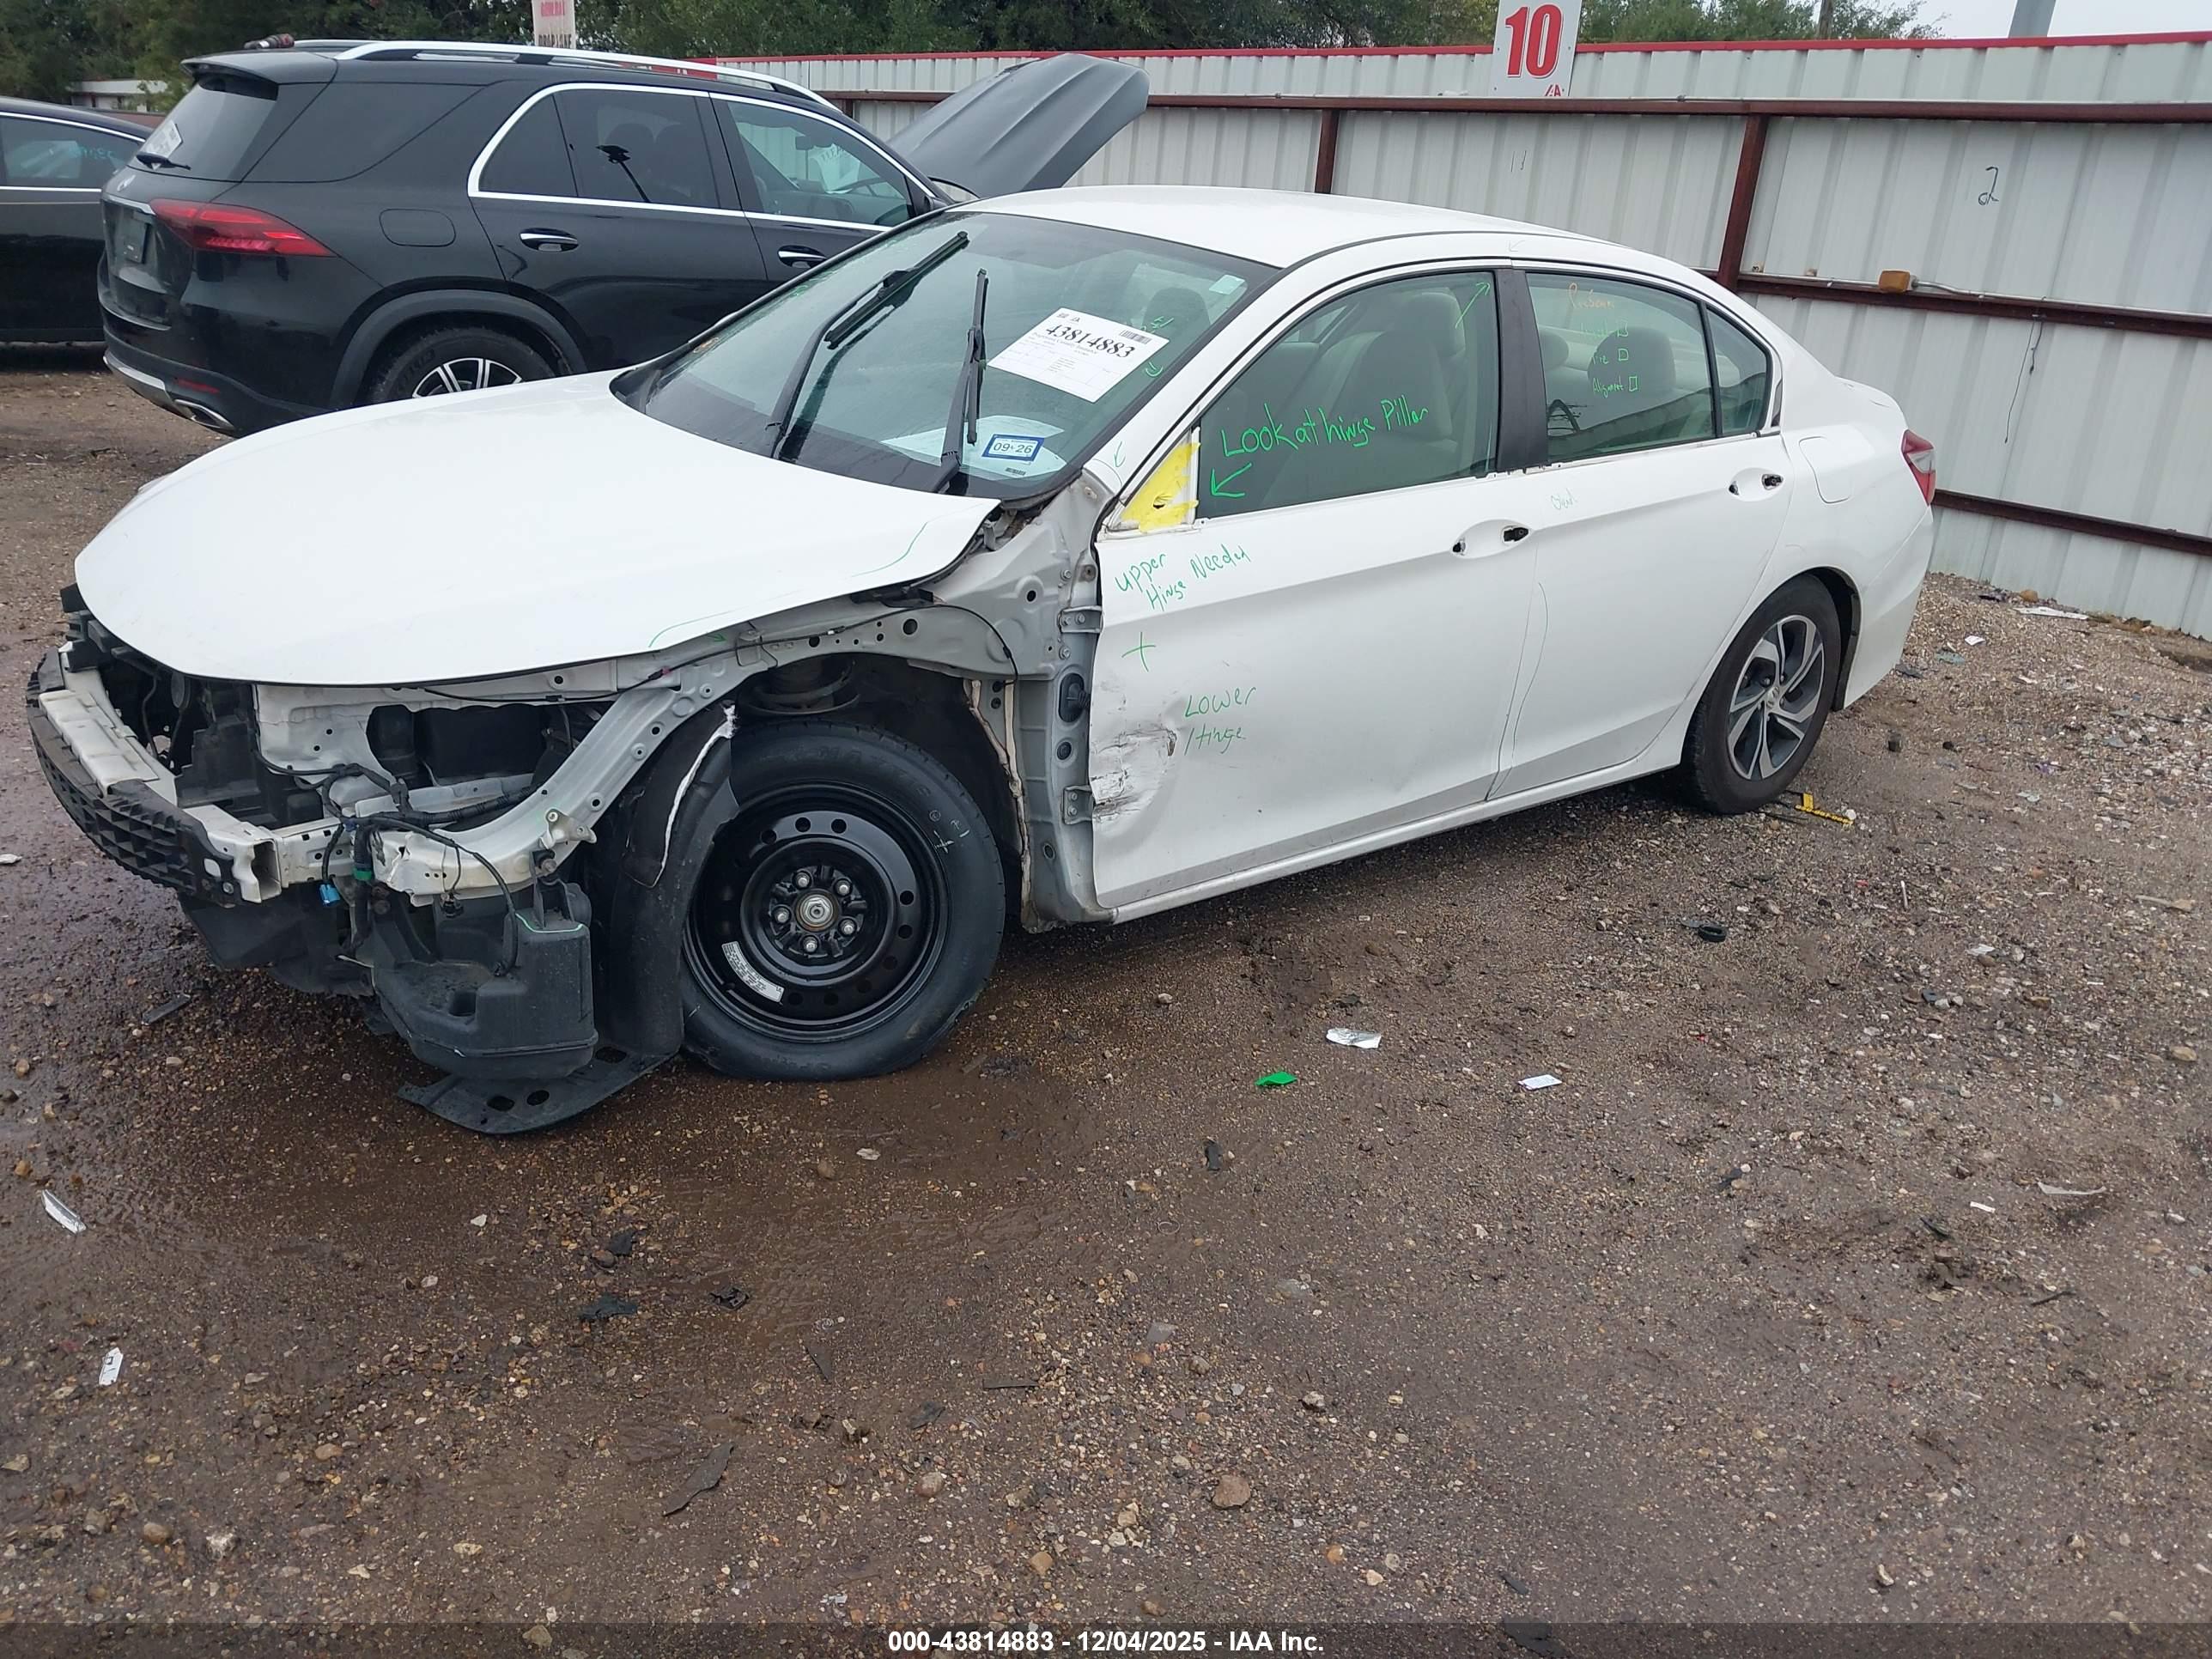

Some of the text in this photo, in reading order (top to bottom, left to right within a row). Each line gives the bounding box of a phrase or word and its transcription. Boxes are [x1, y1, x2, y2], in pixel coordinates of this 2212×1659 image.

[1504, 3, 1564, 79] 10
[1978, 166, 2000, 206] 2
[1046, 324, 1135, 358] 43814883
[1295, 409, 1319, 446] at
